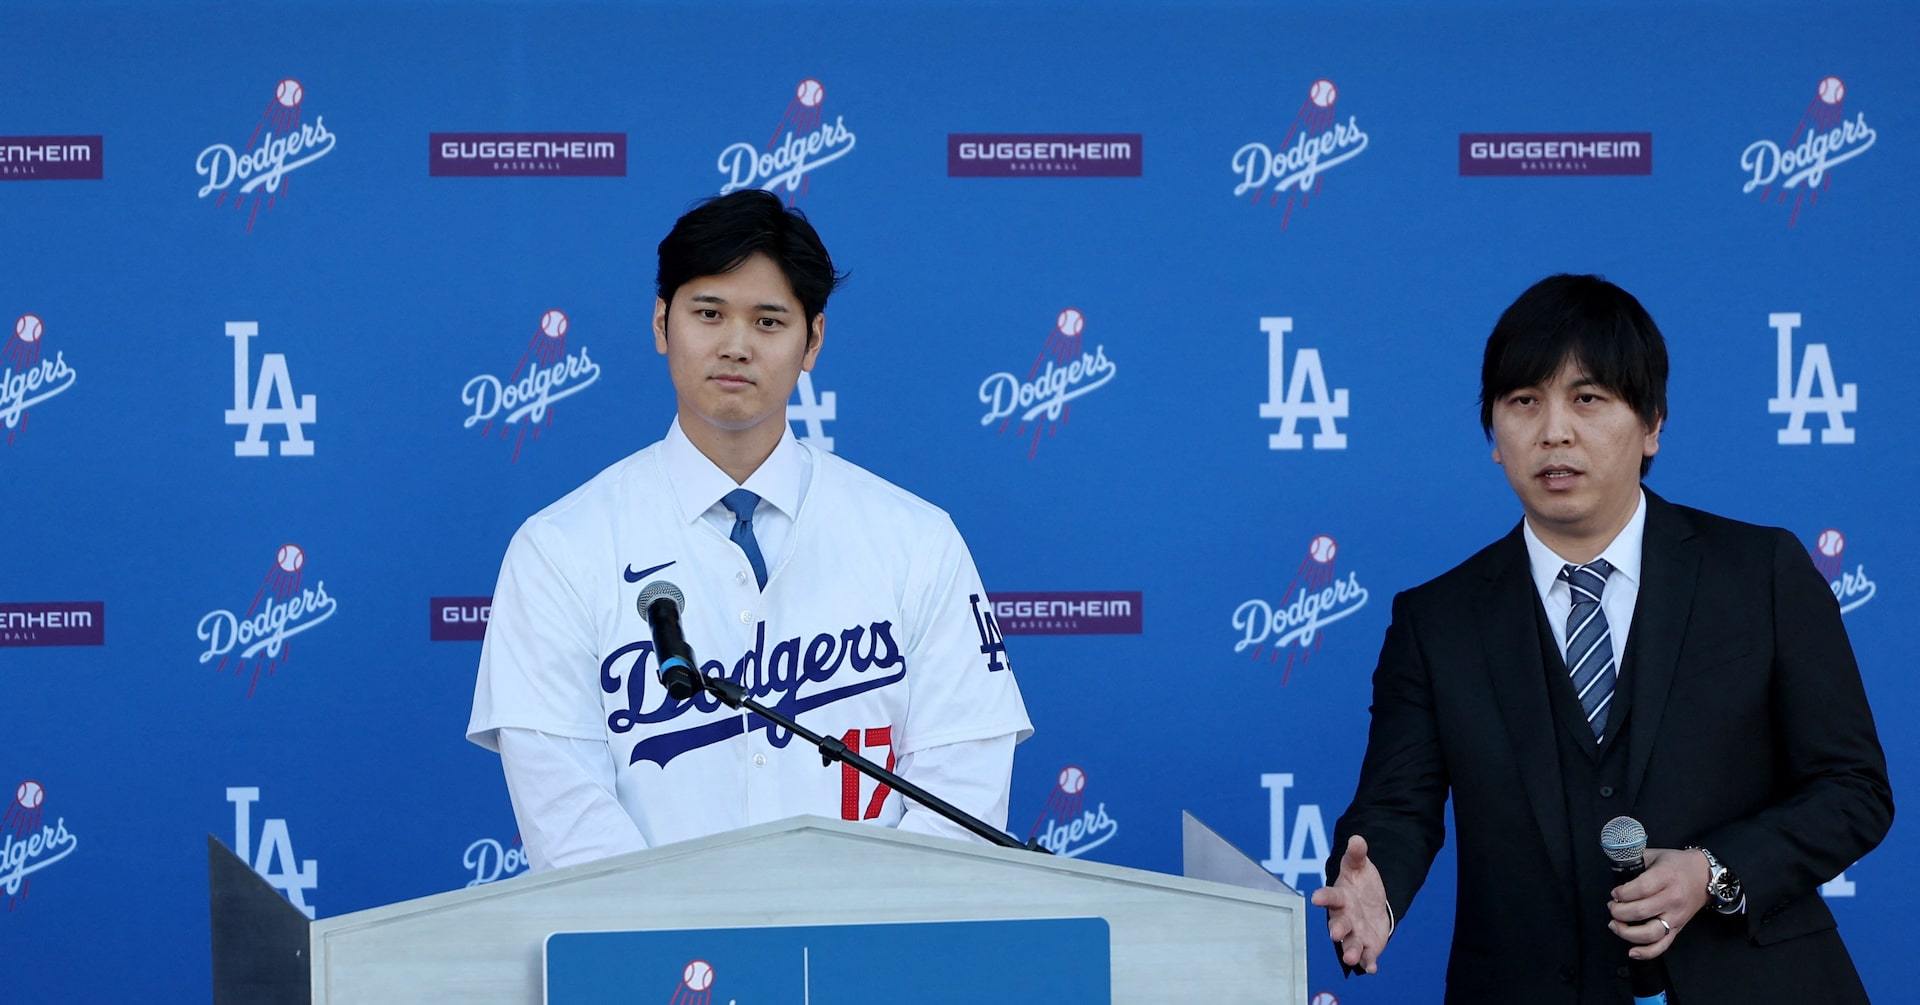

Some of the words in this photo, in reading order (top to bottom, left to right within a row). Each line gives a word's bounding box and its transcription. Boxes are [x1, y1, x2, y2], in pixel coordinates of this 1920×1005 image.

[195, 115, 336, 198] Dodgers
[441, 142, 615, 159] GUGGENHEIM
[493, 162, 560, 170] BASEBALL
[717, 115, 856, 197] Dodgers
[959, 142, 1131, 159] GUGGENHEIM
[1010, 163, 1077, 171] BASEBALL
[1231, 115, 1369, 196] Dodgers
[1470, 141, 1641, 159] GUGGENHEIM
[1740, 112, 1877, 193] Dodgers
[224, 321, 317, 457] LA
[461, 346, 601, 428] Dodgers
[978, 345, 1116, 426] Dodgers
[1259, 316, 1349, 450] LA
[1768, 312, 1858, 445] LA
[197, 581, 337, 664] Dodgers
[991, 600, 1131, 617] GGENHEIM
[1010, 621, 1078, 629] BASEBALL
[1232, 571, 1369, 653] Dodgers
[600, 620, 907, 769] Dodgers
[840, 725, 896, 821] 17
[1006, 802, 1118, 858] dgers
